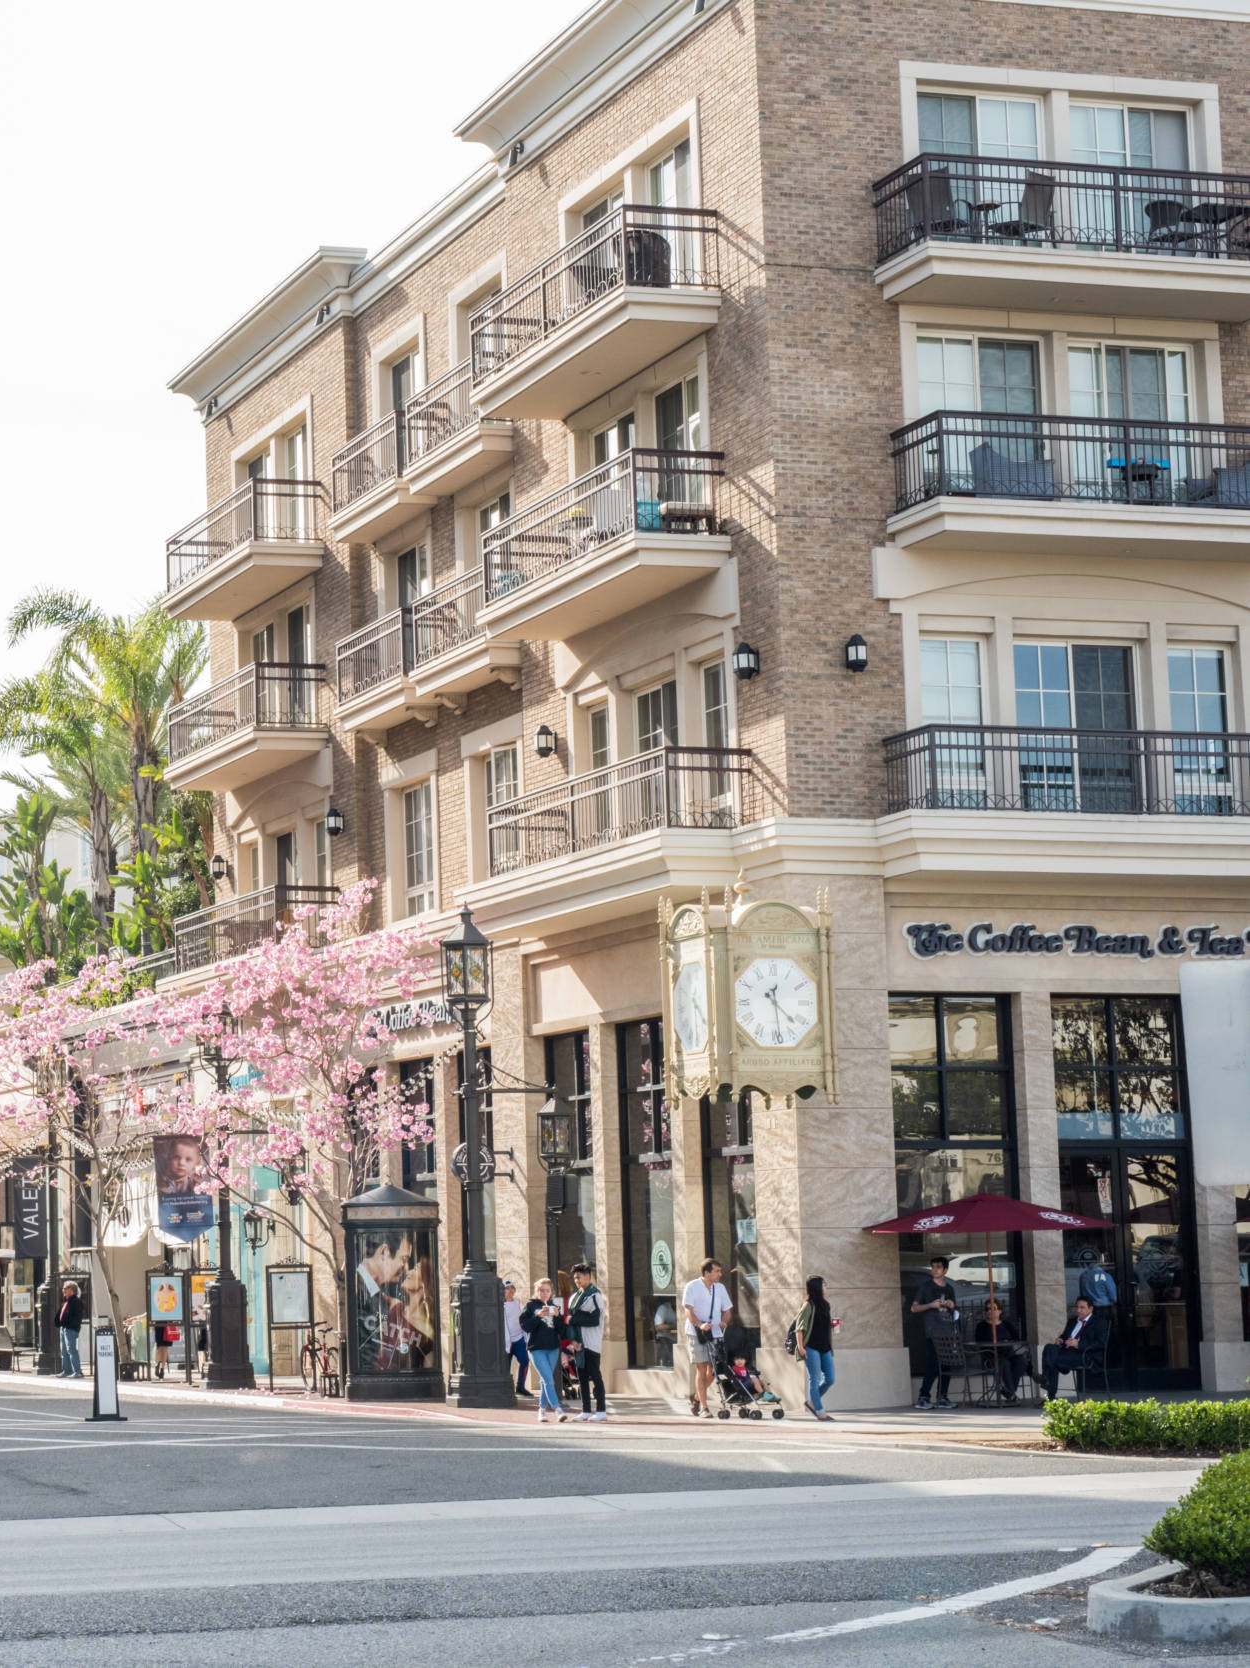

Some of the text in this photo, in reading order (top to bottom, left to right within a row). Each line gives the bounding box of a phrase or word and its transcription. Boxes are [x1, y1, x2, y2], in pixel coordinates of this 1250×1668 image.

[907, 923, 964, 957] The
[968, 923, 1063, 953] Coffee
[1064, 925, 1155, 959] Bean
[1158, 926, 1187, 954] &
[1187, 925, 1245, 955] Tea
[22, 1176, 39, 1239] VALET
[364, 1315, 423, 1349] CATCH
